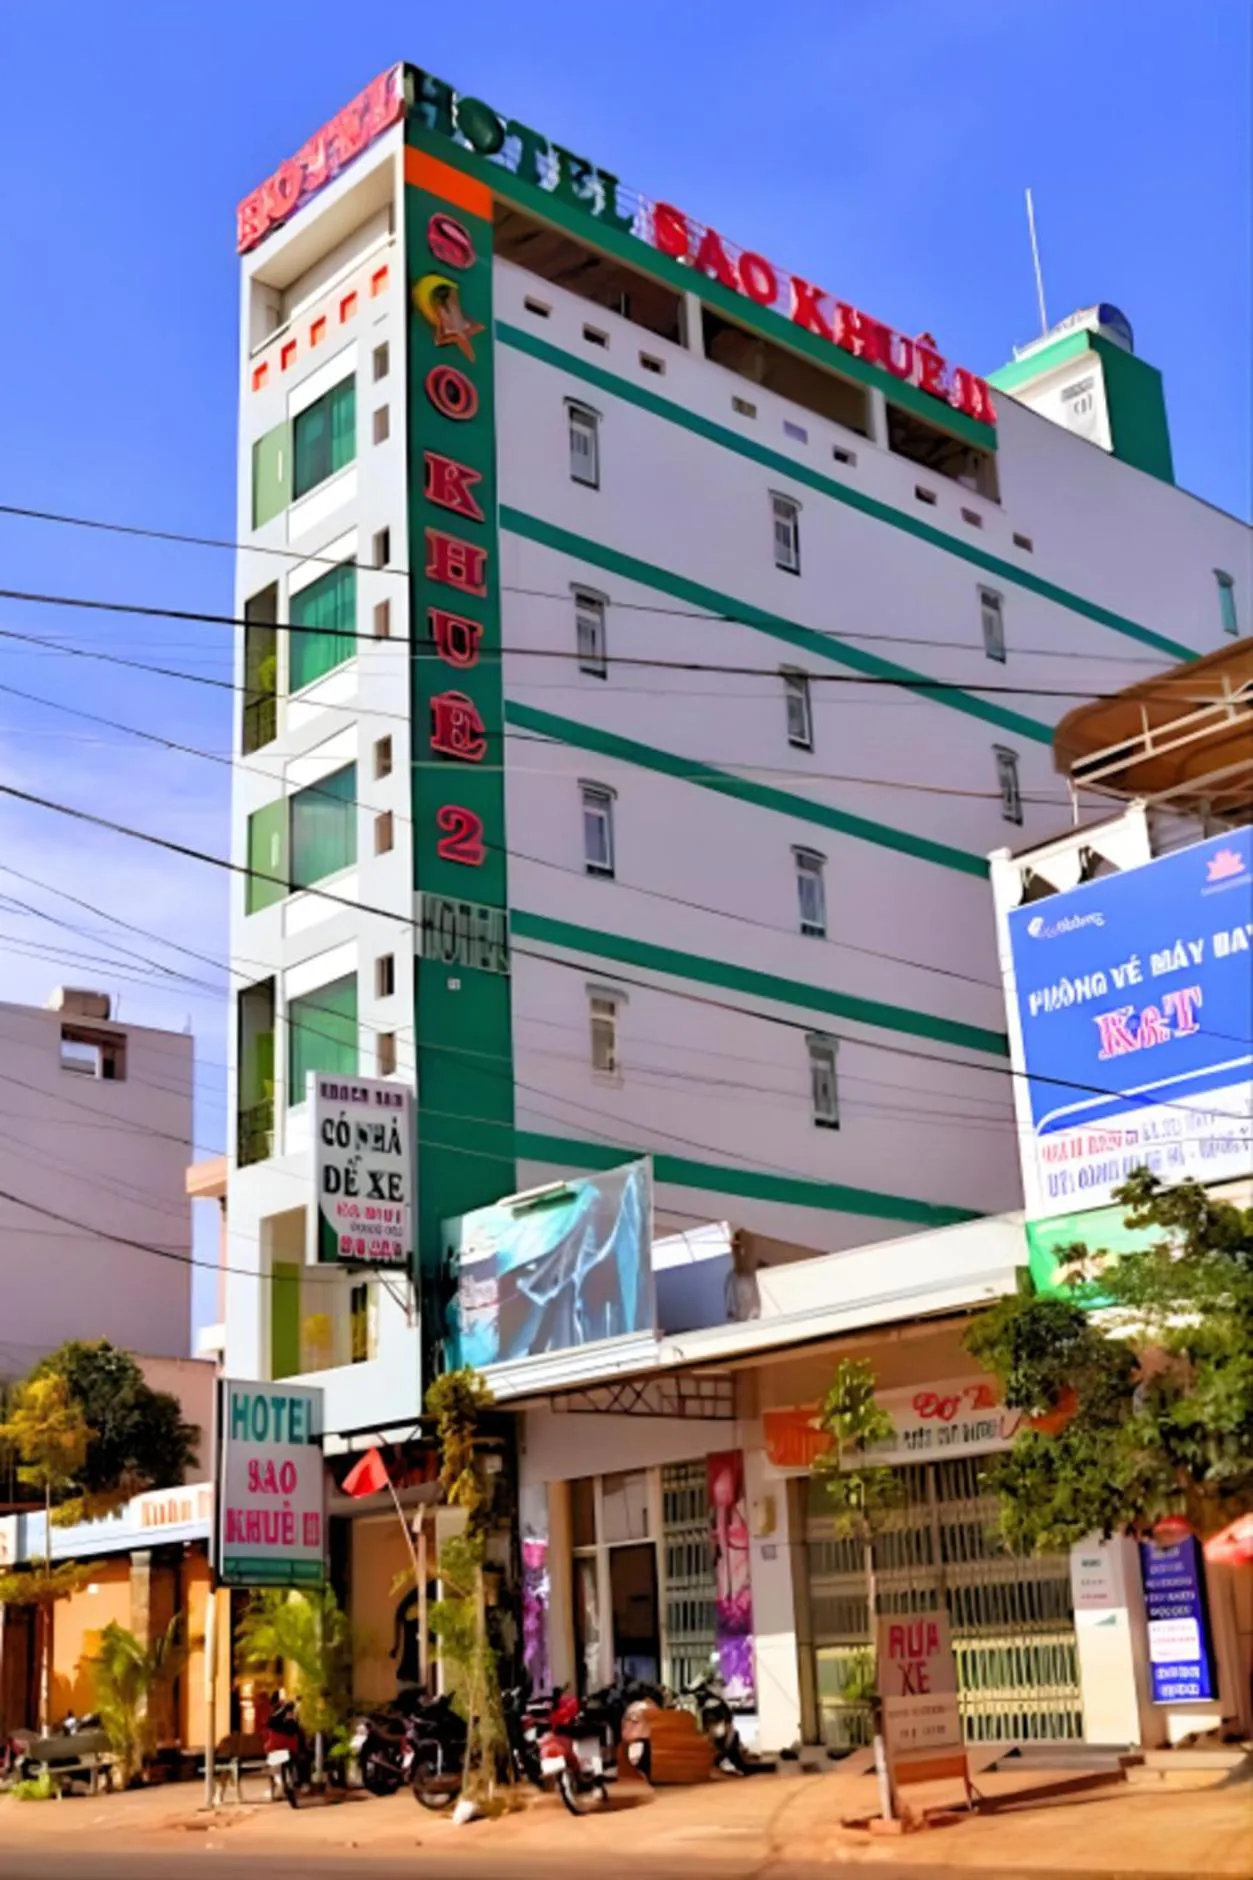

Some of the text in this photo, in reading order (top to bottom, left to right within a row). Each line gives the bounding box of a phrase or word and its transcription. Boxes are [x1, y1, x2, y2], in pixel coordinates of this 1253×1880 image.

[403, 62, 635, 238] HOTEL
[653, 202, 778, 305] SAO
[789, 276, 950, 398] KHUÊ
[436, 804, 487, 867] 2
[1150, 938, 1204, 977] MÁY
[1093, 984, 1204, 1060] K&T
[365, 1170, 404, 1203] XE
[231, 1392, 318, 1444] HOTEL
[247, 1458, 298, 1495] SAO
[898, 1661, 931, 1697] XE
